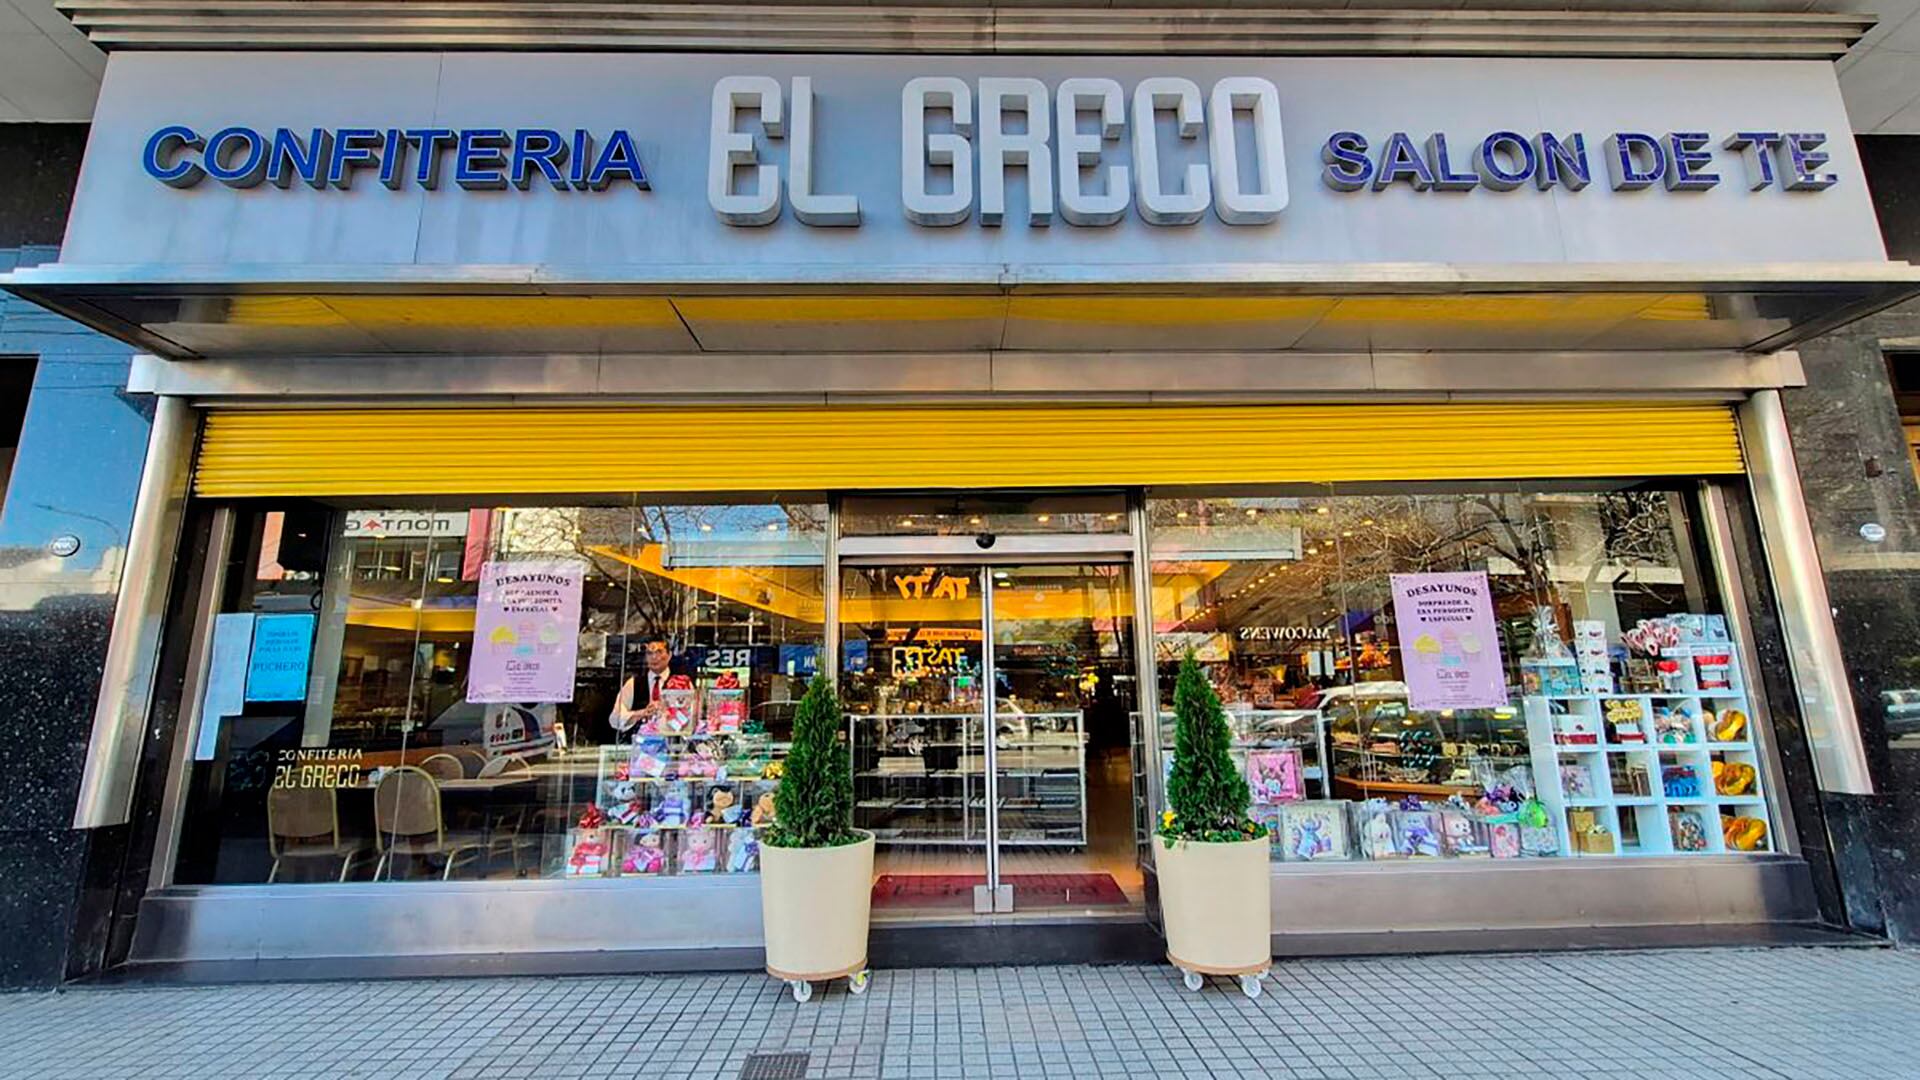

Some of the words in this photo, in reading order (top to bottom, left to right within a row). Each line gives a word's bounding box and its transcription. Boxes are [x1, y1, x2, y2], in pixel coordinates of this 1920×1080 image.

[142, 125, 648, 188] CONFITERIA
[707, 76, 861, 224] EL
[901, 76, 1290, 226] GRECO
[1324, 131, 1591, 190] SALON
[1607, 132, 1720, 190] DE
[1724, 132, 1838, 190] TE
[496, 573, 571, 587] DESAYUNOS
[1406, 583, 1478, 597] DESAYUNOS
[253, 662, 305, 672] PUCHERO
[278, 748, 363, 761] CONFITERIA
[300, 764, 361, 788] GRECO
